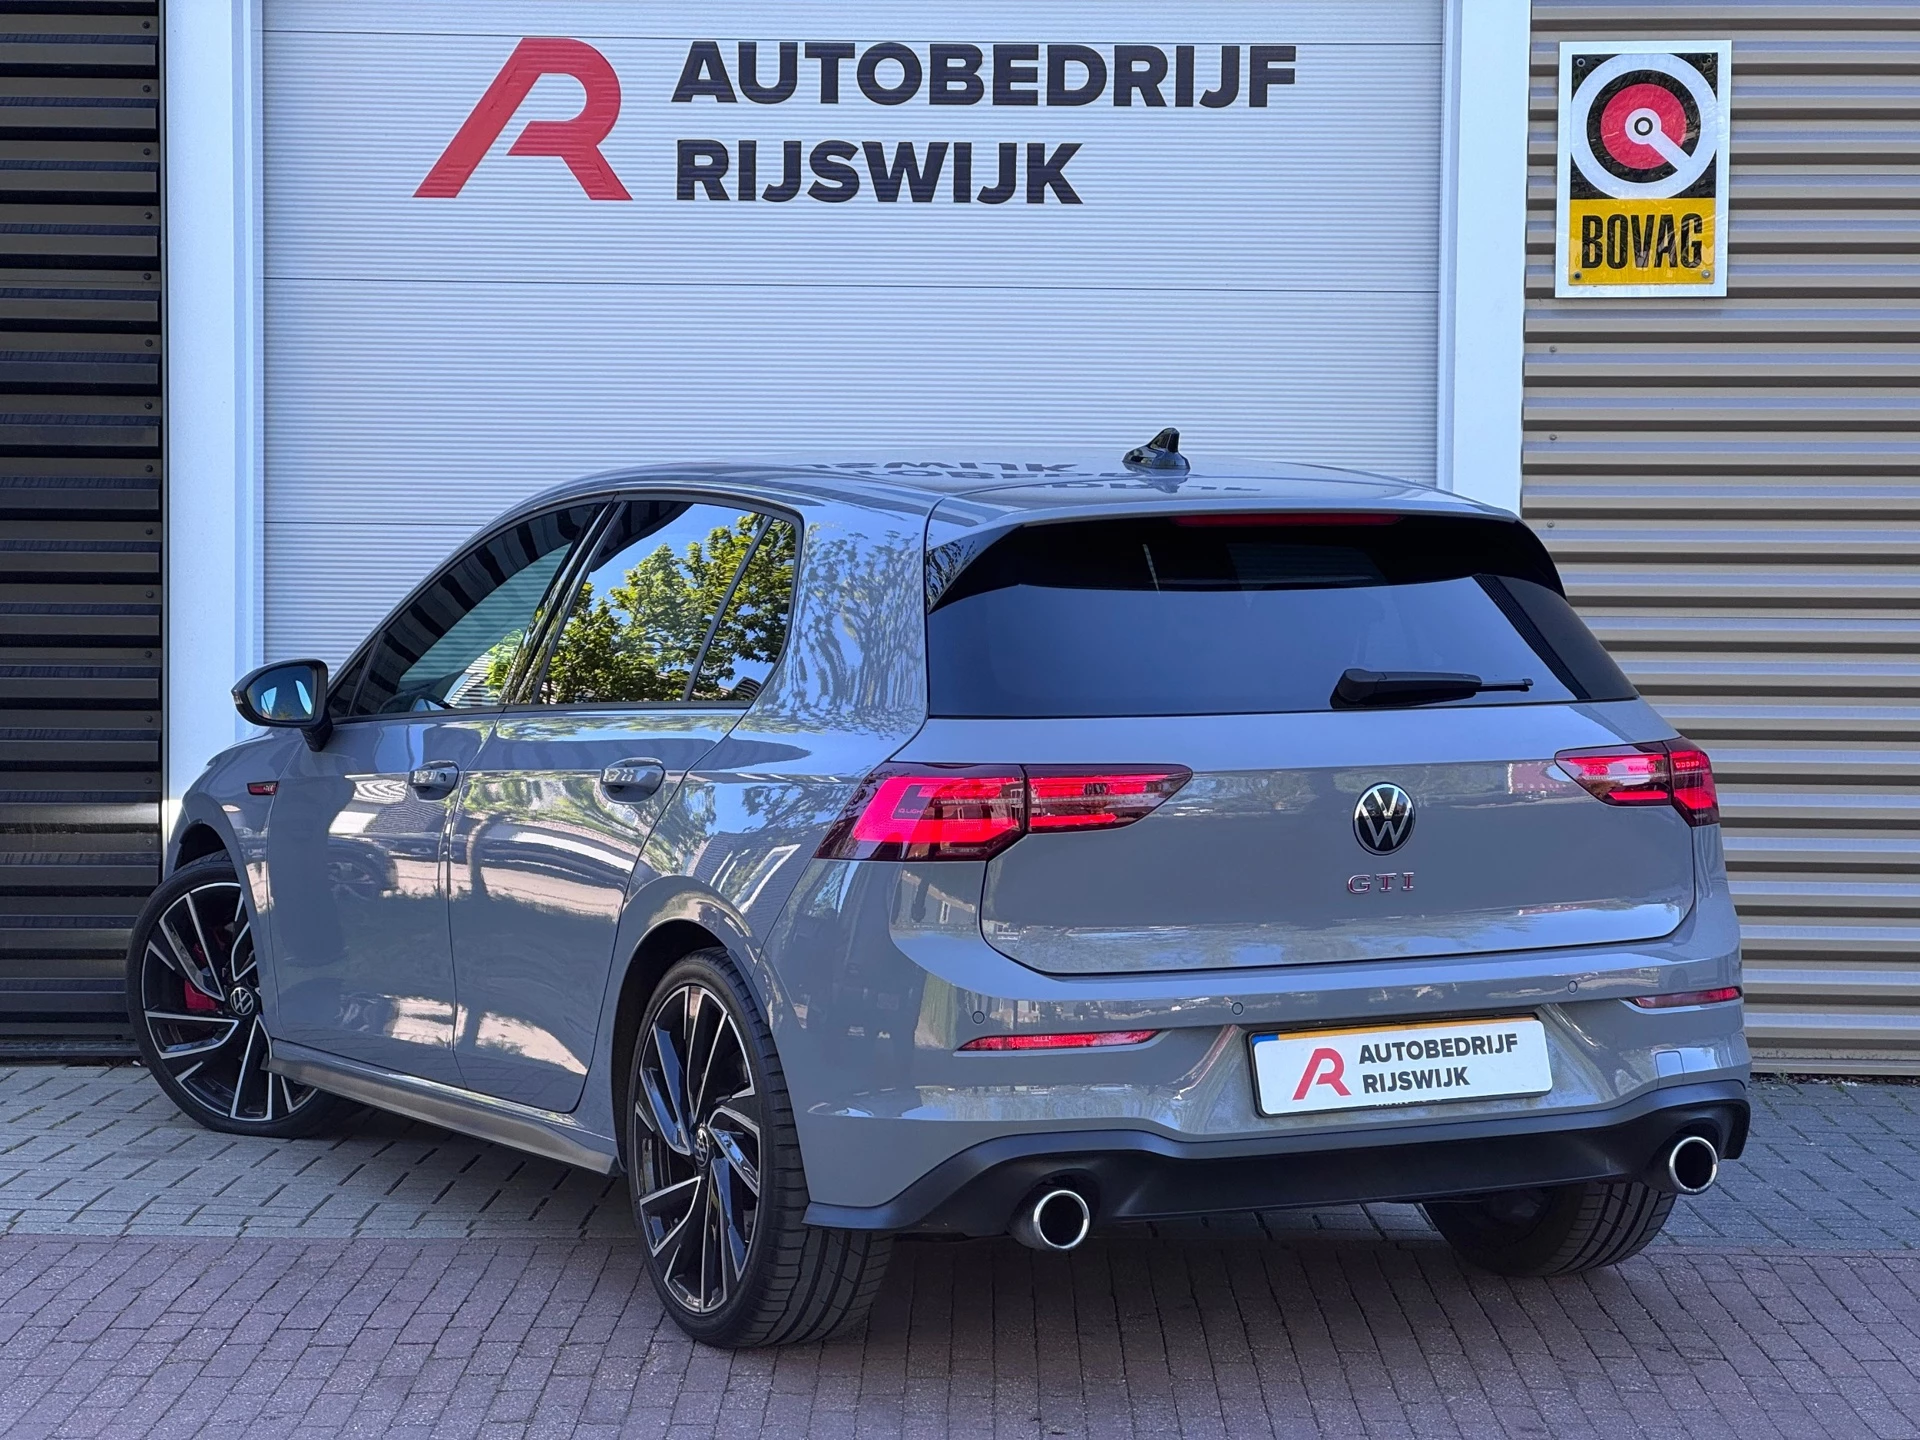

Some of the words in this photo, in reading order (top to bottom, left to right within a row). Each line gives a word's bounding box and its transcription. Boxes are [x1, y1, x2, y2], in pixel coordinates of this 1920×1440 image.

[671, 41, 1297, 108] AUTOBEDRIJF
[677, 140, 1083, 205] RIJSWIJK
[1581, 213, 1703, 269] BOVAG
[1346, 871, 1416, 895] GTI
[1358, 1033, 1519, 1065] AUTOBEDRIJF
[1362, 1066, 1471, 1094] RIJSWIJK
